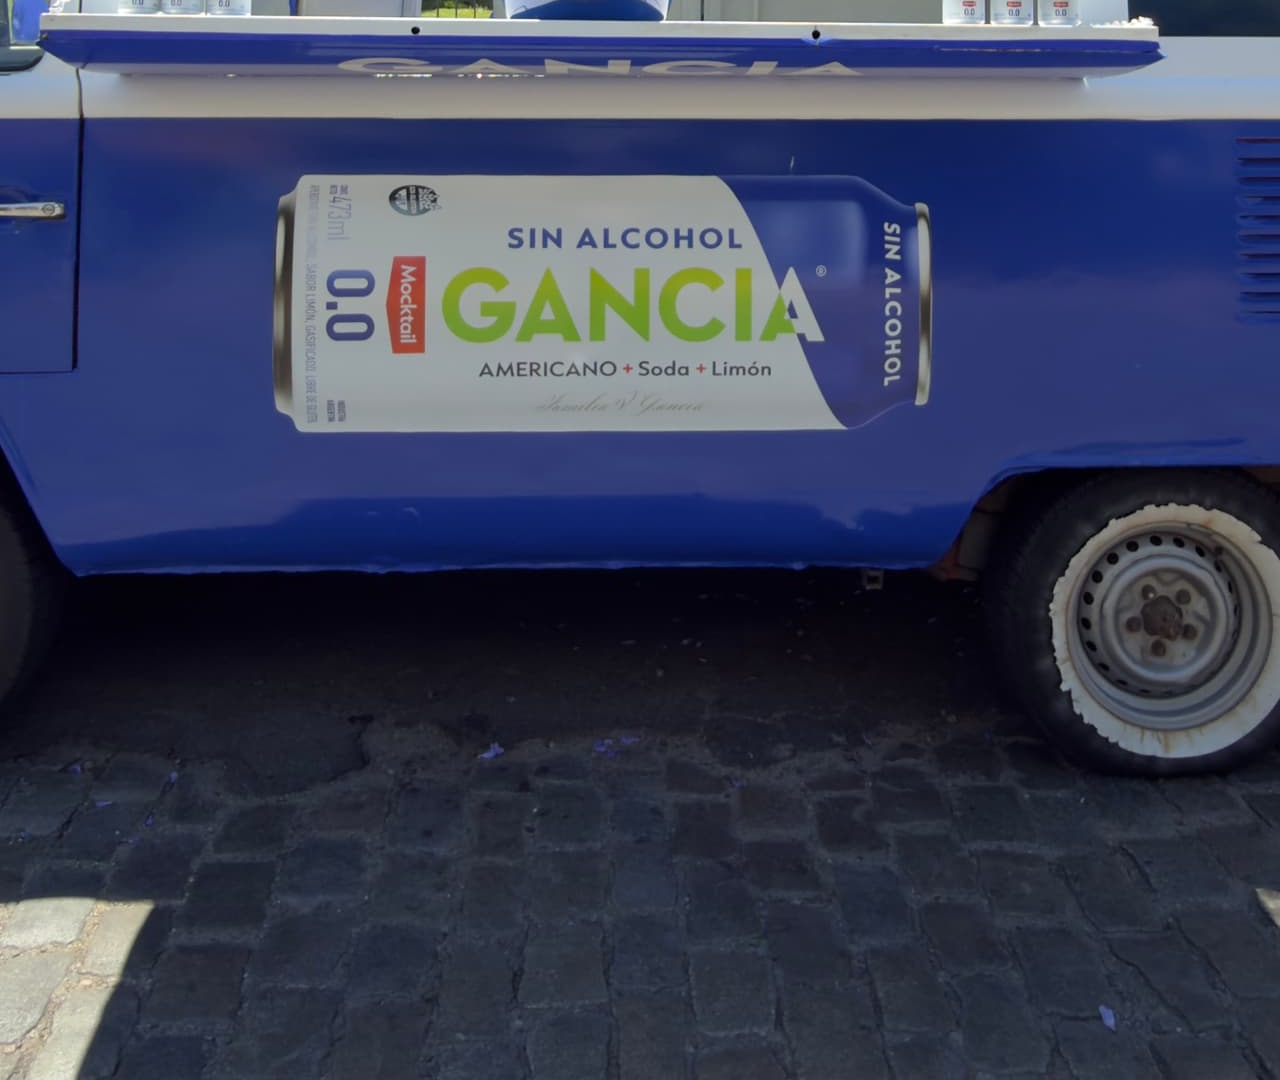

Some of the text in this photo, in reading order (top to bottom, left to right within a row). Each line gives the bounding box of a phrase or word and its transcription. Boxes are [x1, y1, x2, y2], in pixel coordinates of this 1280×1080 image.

[337, 57, 865, 76] GANCIA
[507, 227, 743, 249] SIN ALCOHOL
[325, 269, 376, 342] 0.0
[399, 264, 418, 344] Mocktail
[441, 266, 825, 344] GANCIA
[883, 222, 902, 387] SIN ALCOHOL
[478, 360, 617, 377] AMERICANO
[638, 360, 690, 377] Soda
[711, 360, 773, 377] Limón
